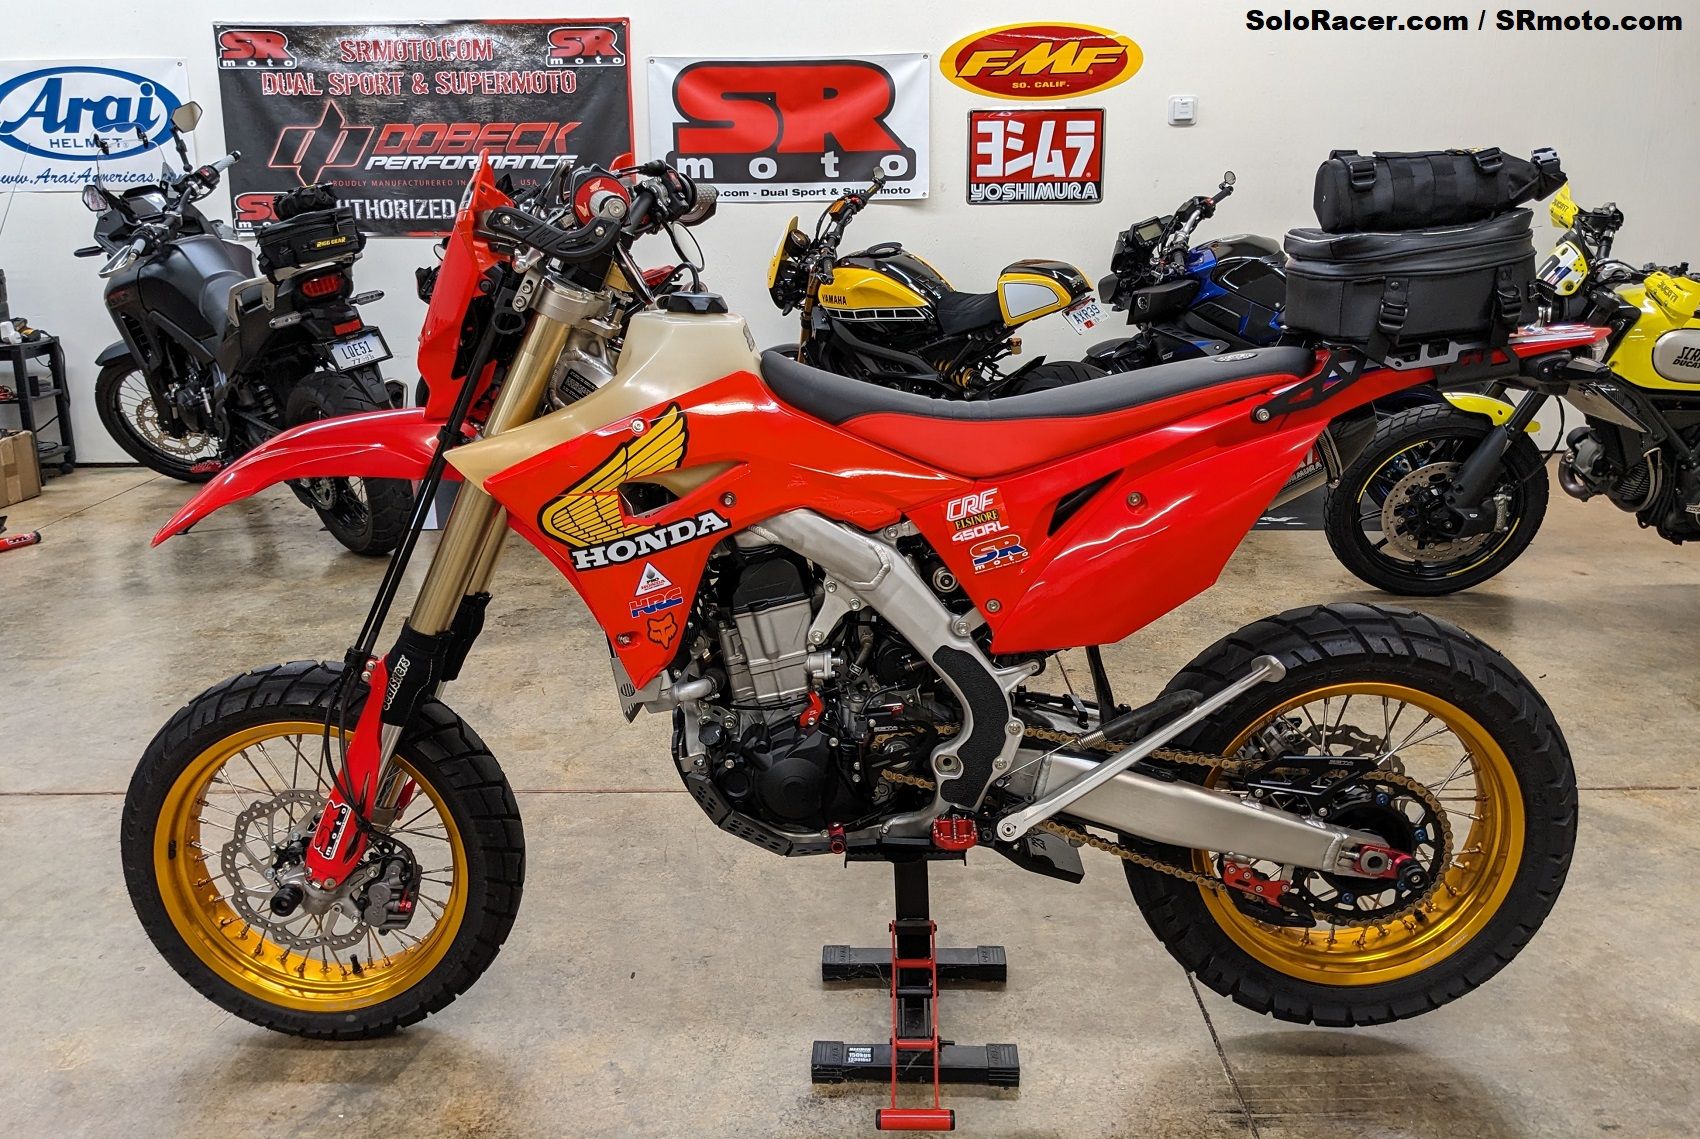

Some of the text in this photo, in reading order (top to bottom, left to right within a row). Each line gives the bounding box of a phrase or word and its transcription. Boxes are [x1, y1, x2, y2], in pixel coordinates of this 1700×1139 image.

[220, 31, 291, 59] SR
[340, 38, 493, 62] SRMOTO.COM
[549, 29, 620, 57] SR
[223, 59, 293, 67] moto
[550, 57, 622, 65] moto
[956, 40, 1128, 77] FMF
[261, 70, 577, 96] DUAL SPORT & SUPERMOTO
[0, 78, 161, 133] Arai
[674, 63, 903, 154] SR
[372, 121, 582, 154] DOBECK
[976, 119, 1096, 179] ヨシムラ
[676, 151, 908, 180] moto
[761, 188, 788, 197] Dual
[792, 186, 827, 198] Sport
[830, 187, 839, 196] &
[970, 182, 1098, 201] YOSHIMURA
[822, 294, 847, 305] YAMAHA
[1072, 304, 1100, 324] AXR39
[946, 488, 998, 521] CRF
[952, 521, 1010, 541] 450RL
[955, 509, 999, 530] ELSINORE
[572, 511, 729, 571] HONDA
[629, 586, 683, 618] HRC
